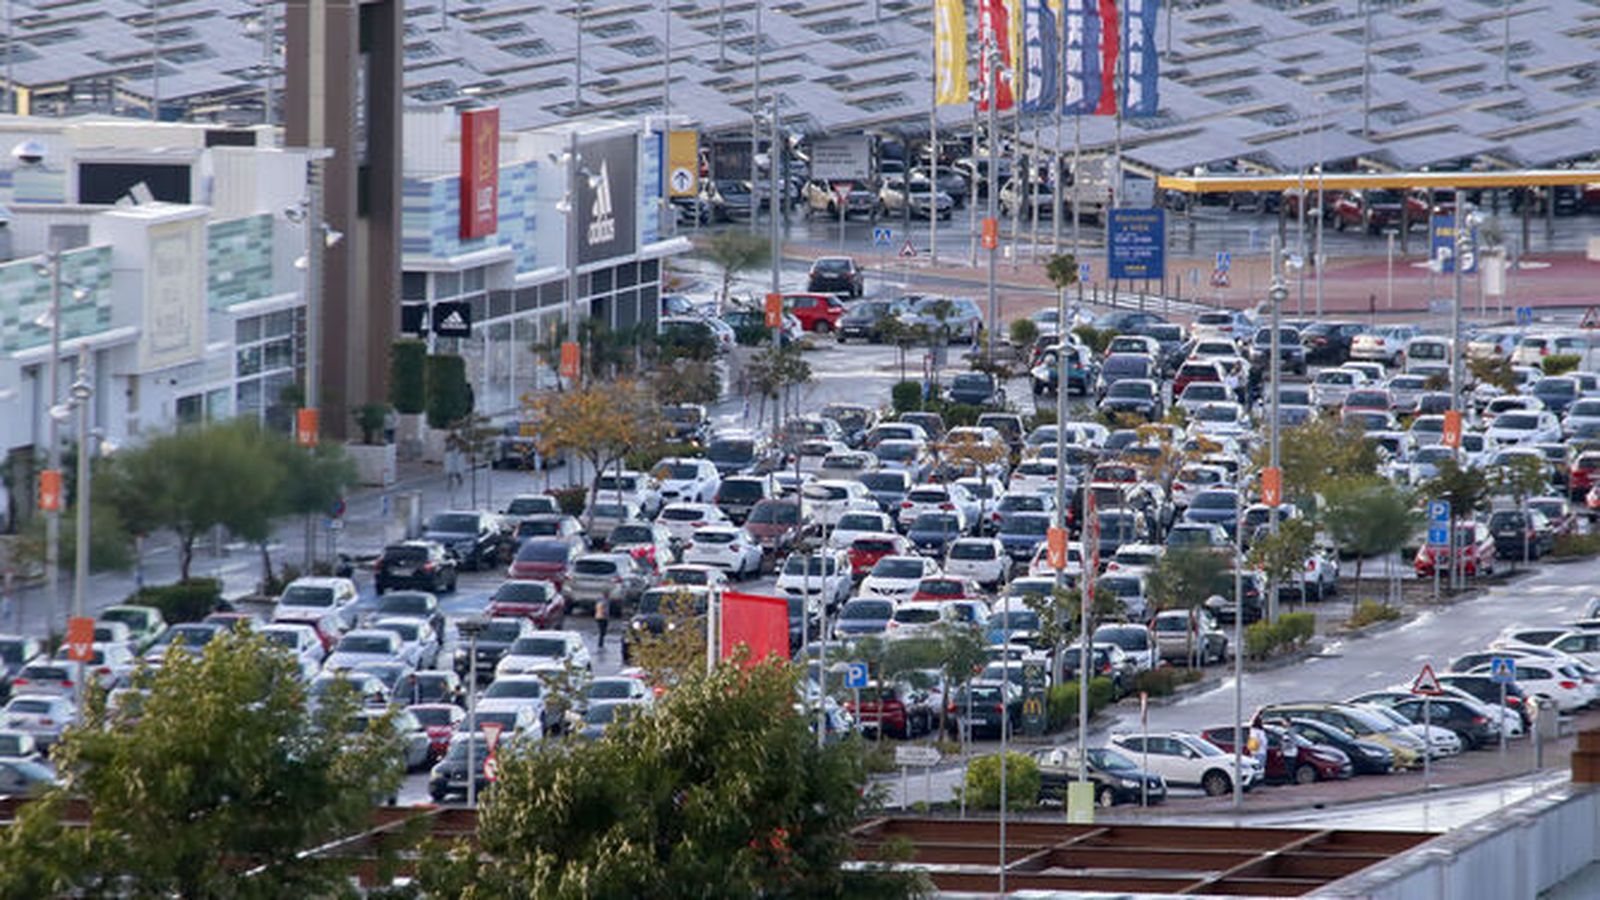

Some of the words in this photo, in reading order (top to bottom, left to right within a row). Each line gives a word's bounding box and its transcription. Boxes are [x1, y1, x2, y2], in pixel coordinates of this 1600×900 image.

[1431, 503, 1445, 520] P
[1050, 549, 1059, 565] V
[71, 642, 87, 657] V
[848, 666, 863, 685] P
